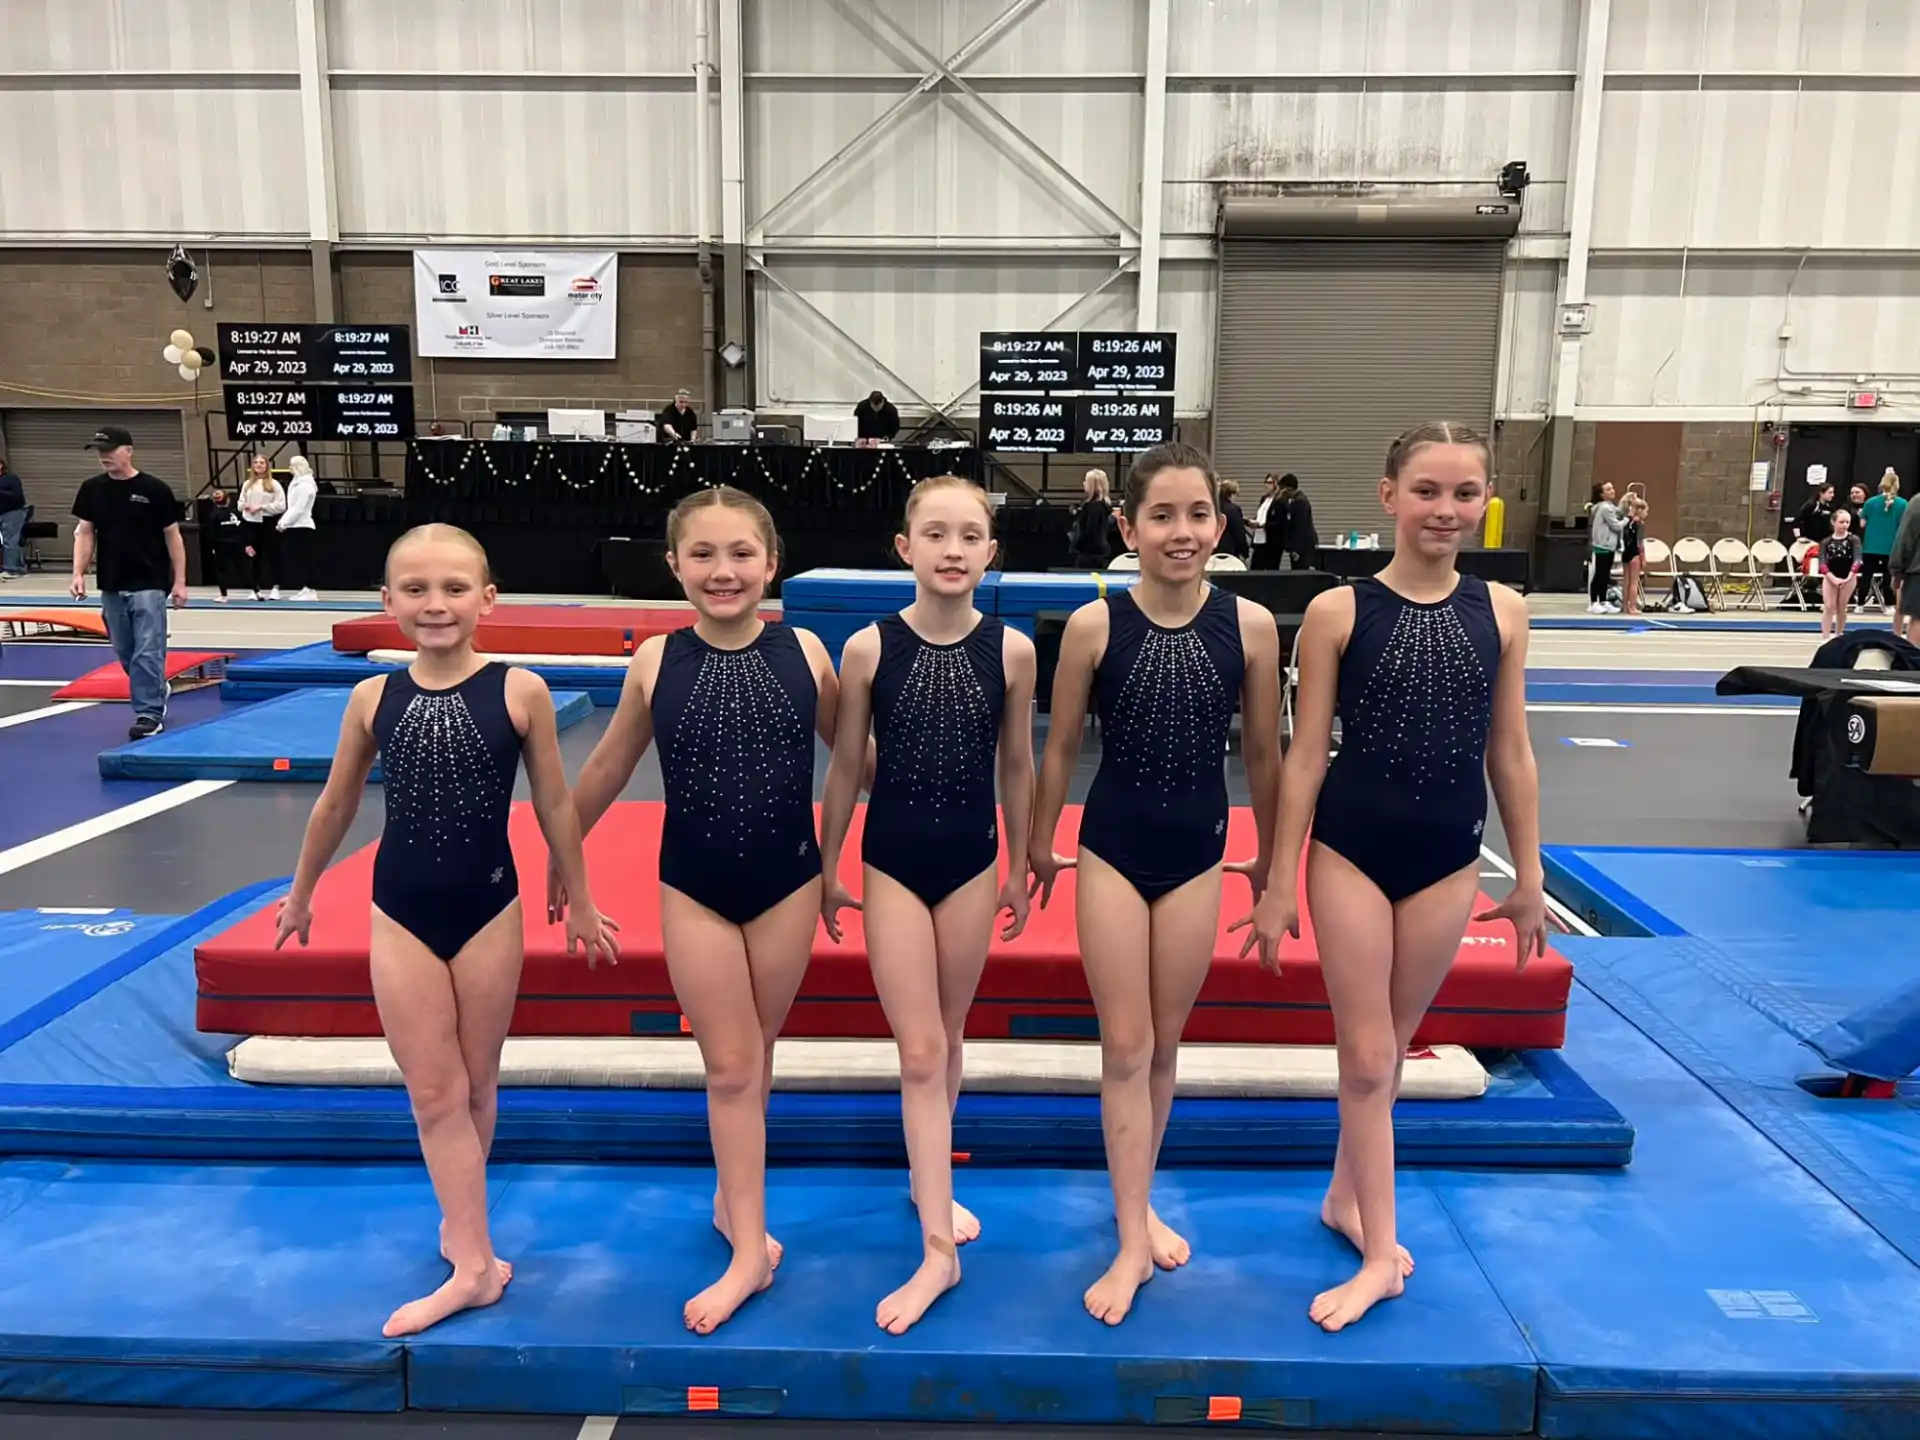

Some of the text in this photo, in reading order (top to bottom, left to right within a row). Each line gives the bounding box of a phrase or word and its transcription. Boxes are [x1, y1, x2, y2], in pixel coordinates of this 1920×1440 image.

[490, 277, 519, 286] GREAT
[522, 312, 549, 320] Sponsors
[231, 331, 301, 344] 8:19:27 AM
[334, 333, 389, 343] 8:19:27 AM
[993, 341, 1064, 353] 8:19:27 AM
[1092, 340, 1162, 353] 8:19:26 AM
[229, 361, 307, 375] Apr 29, 2023
[333, 363, 394, 374] Apr 29, 2023
[1087, 365, 1164, 379] Apr 29, 2023
[989, 371, 1068, 383] Apr 29, 2023
[237, 392, 306, 405] 8:19:27 AM
[338, 394, 393, 404] 8:19:27 AM
[993, 403, 1062, 416] 8:19:26 AM
[1091, 403, 1159, 416] 8:19:26 AM
[236, 421, 312, 436] Apr 29, 2023
[337, 423, 398, 435] Apr 29, 2023
[989, 428, 1065, 442] Apr 29, 2023
[1086, 428, 1162, 442] Apr 29, 2023
